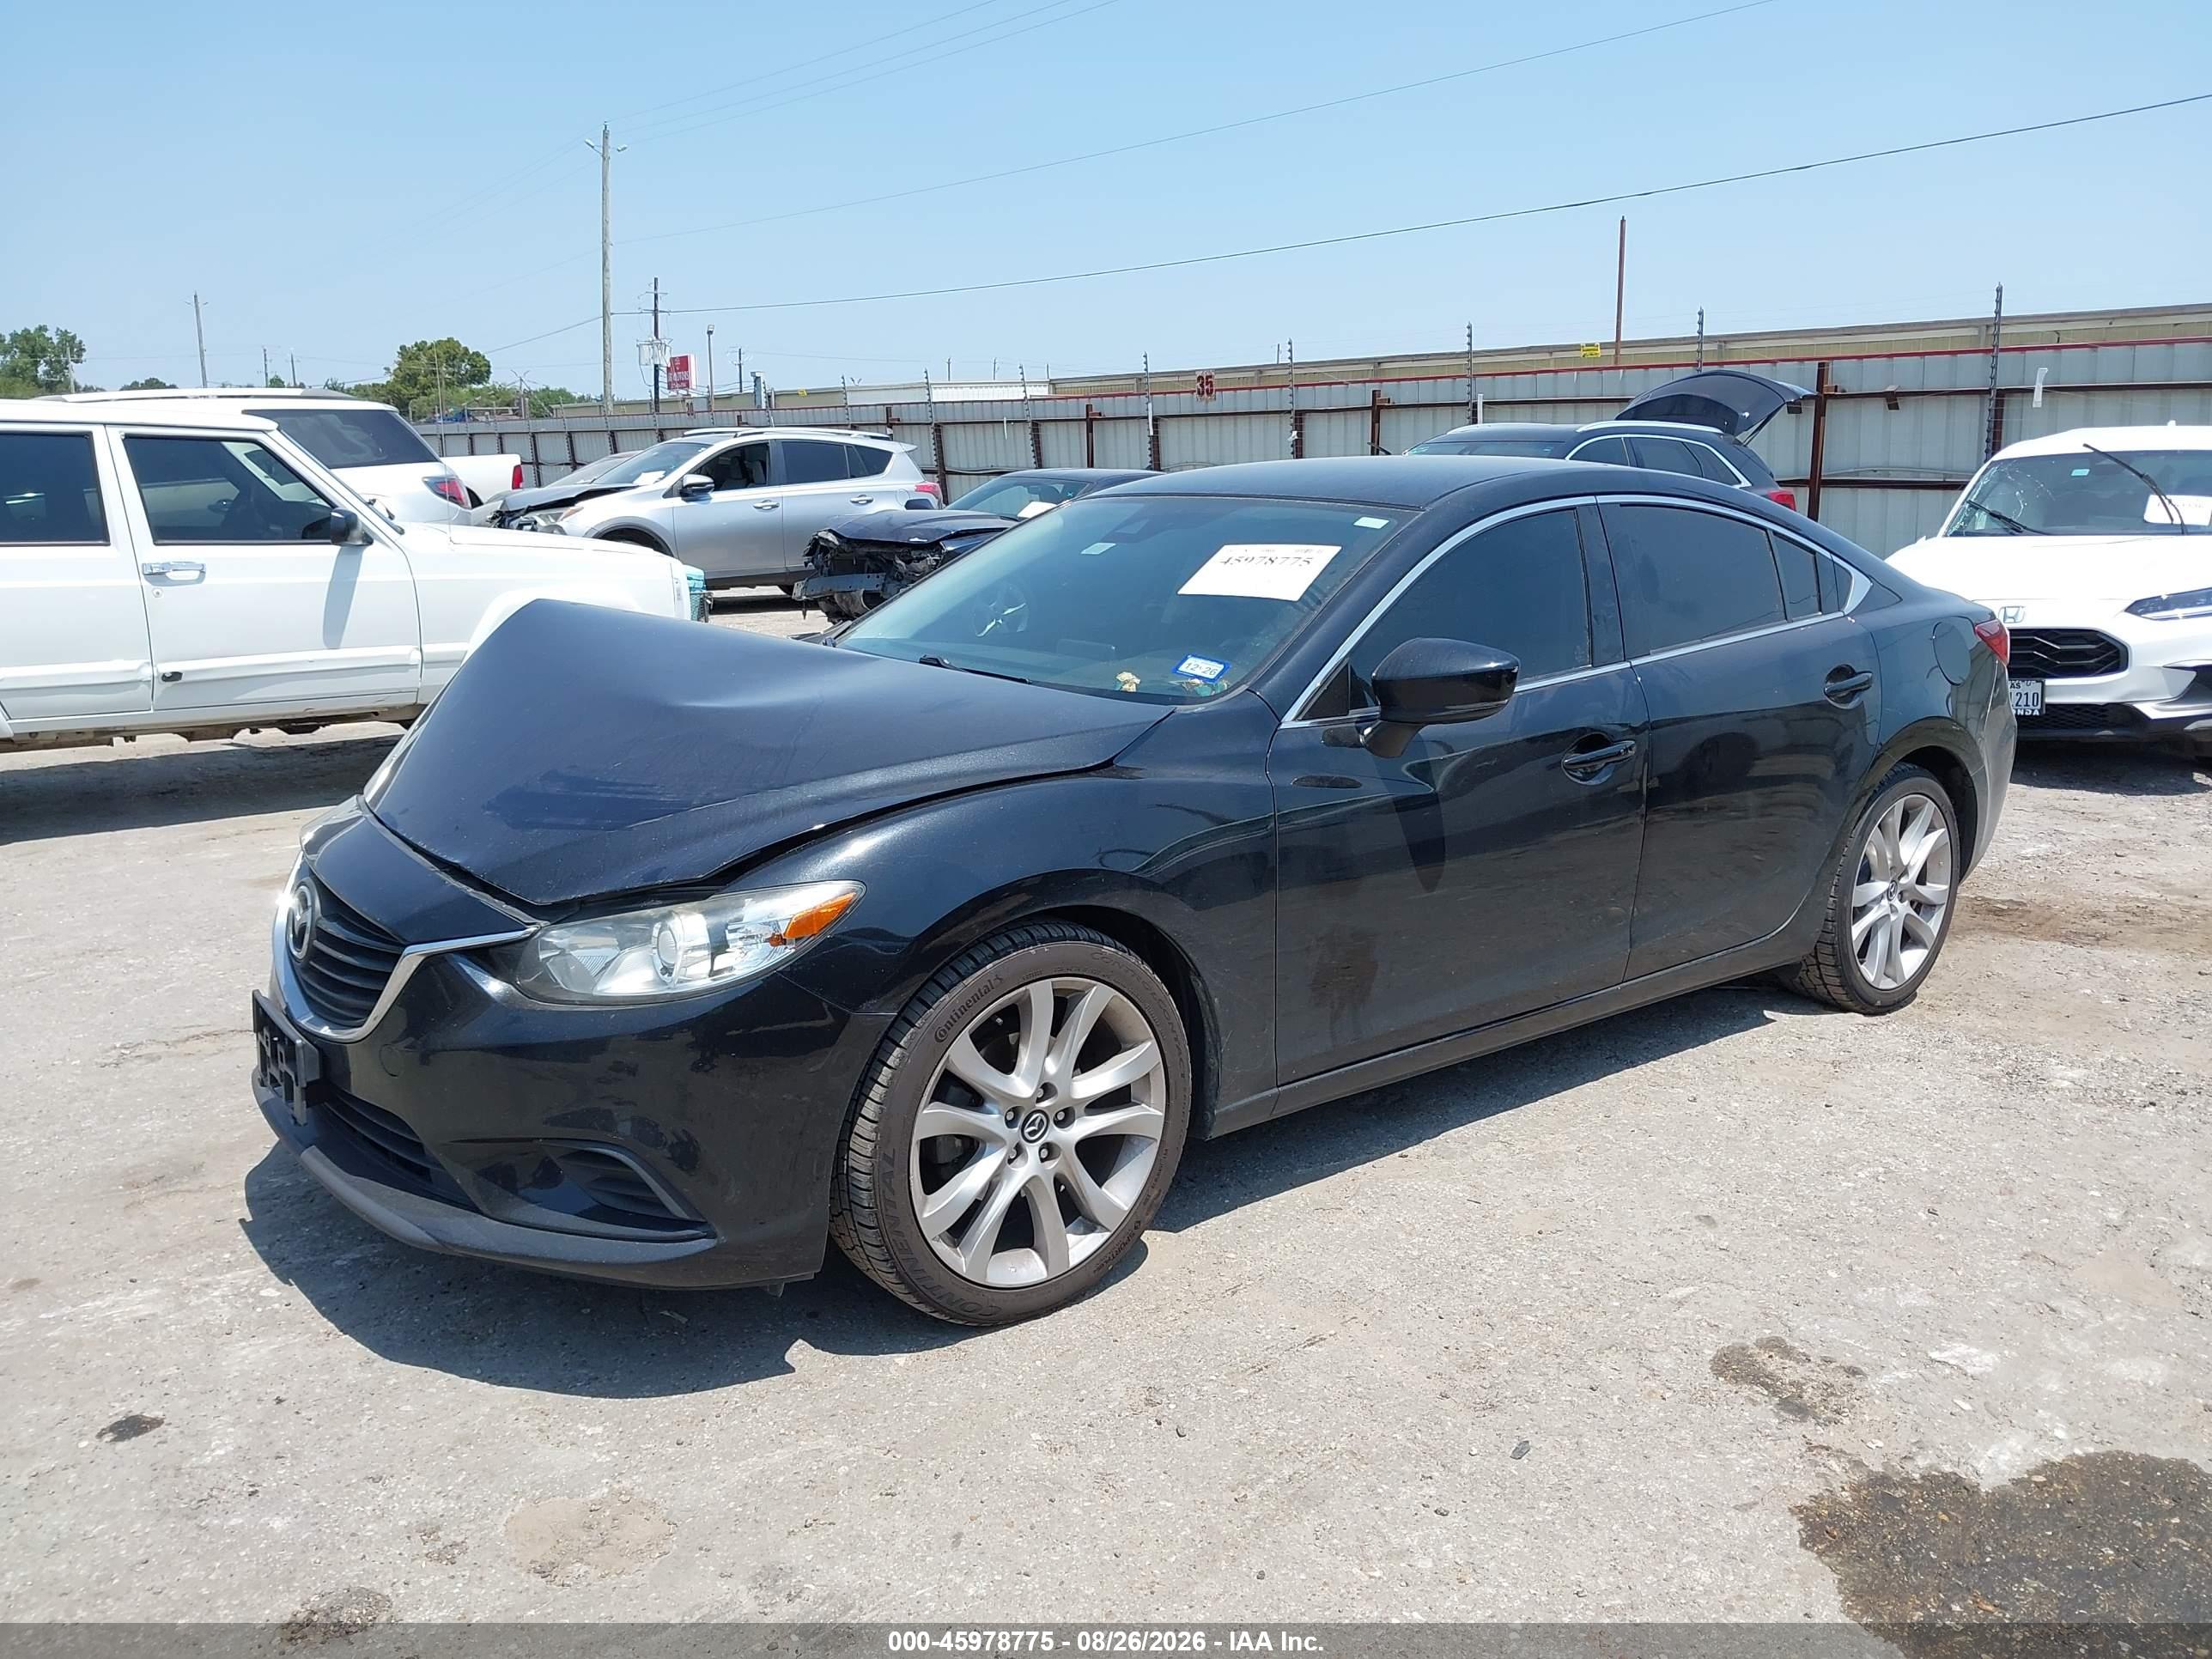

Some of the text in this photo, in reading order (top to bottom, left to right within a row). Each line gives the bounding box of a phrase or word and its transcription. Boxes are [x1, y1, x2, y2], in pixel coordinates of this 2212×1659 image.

[1196, 375, 1214, 397] 35
[1220, 556, 1313, 567] 45978775
[934, 979, 995, 1043] Continental
[878, 1148, 1003, 1317] CONTINENTAL
